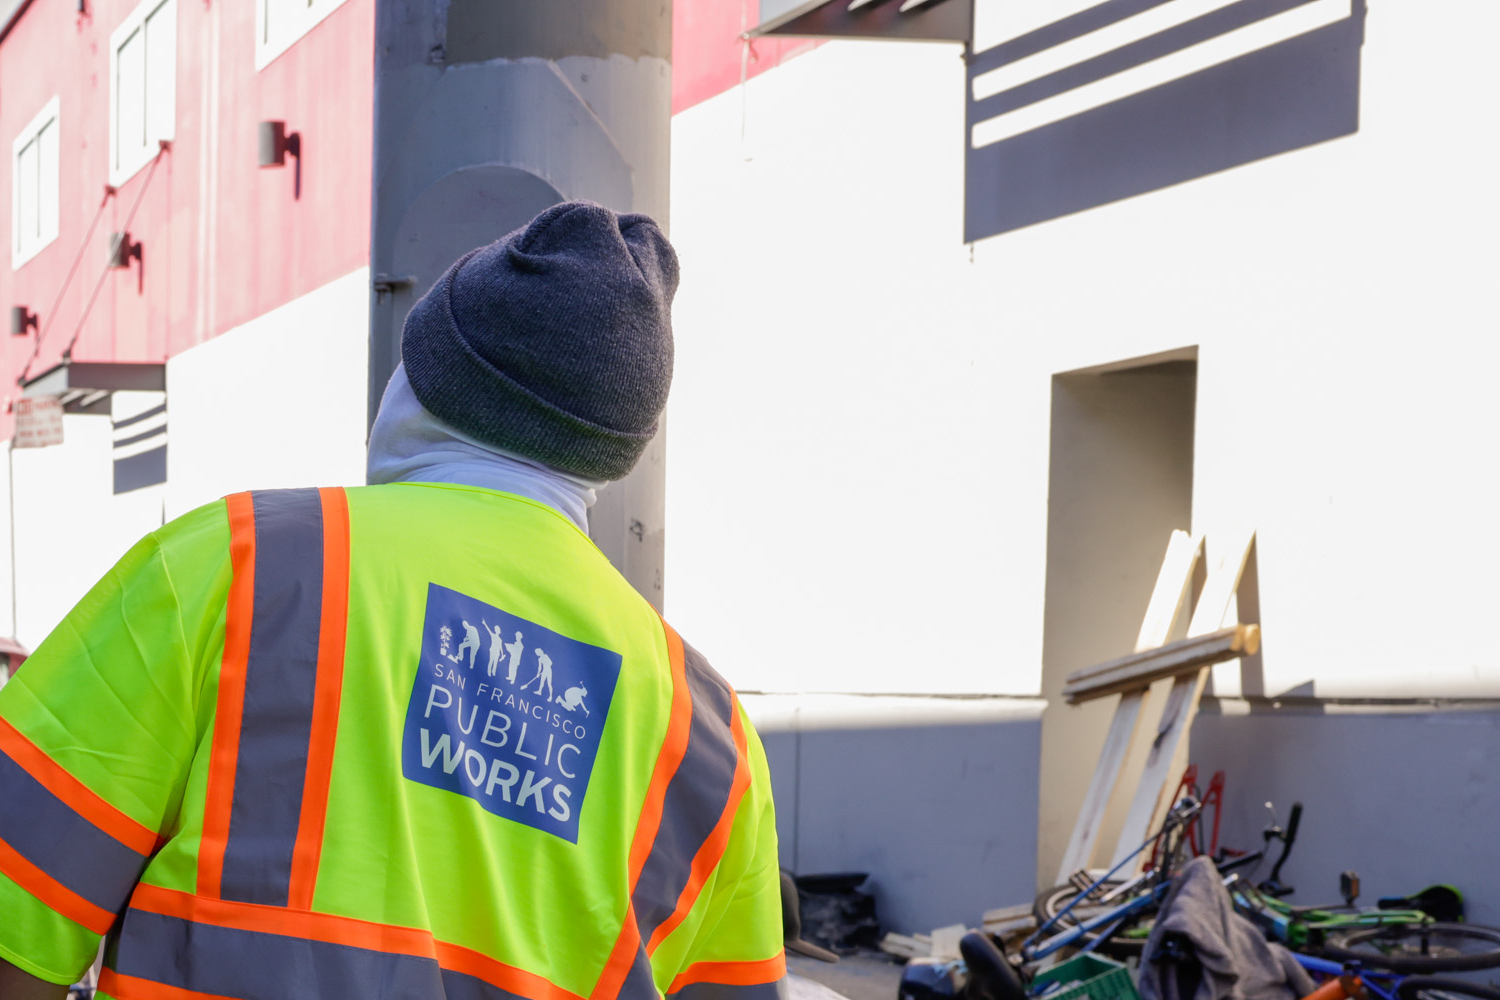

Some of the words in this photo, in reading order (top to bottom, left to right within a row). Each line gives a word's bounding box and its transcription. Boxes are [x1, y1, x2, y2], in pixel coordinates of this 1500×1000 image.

[424, 684, 581, 779] PUBLIC
[435, 663, 466, 690] SAN
[477, 683, 586, 739] FRANCISCO
[420, 727, 572, 822] WORKS
